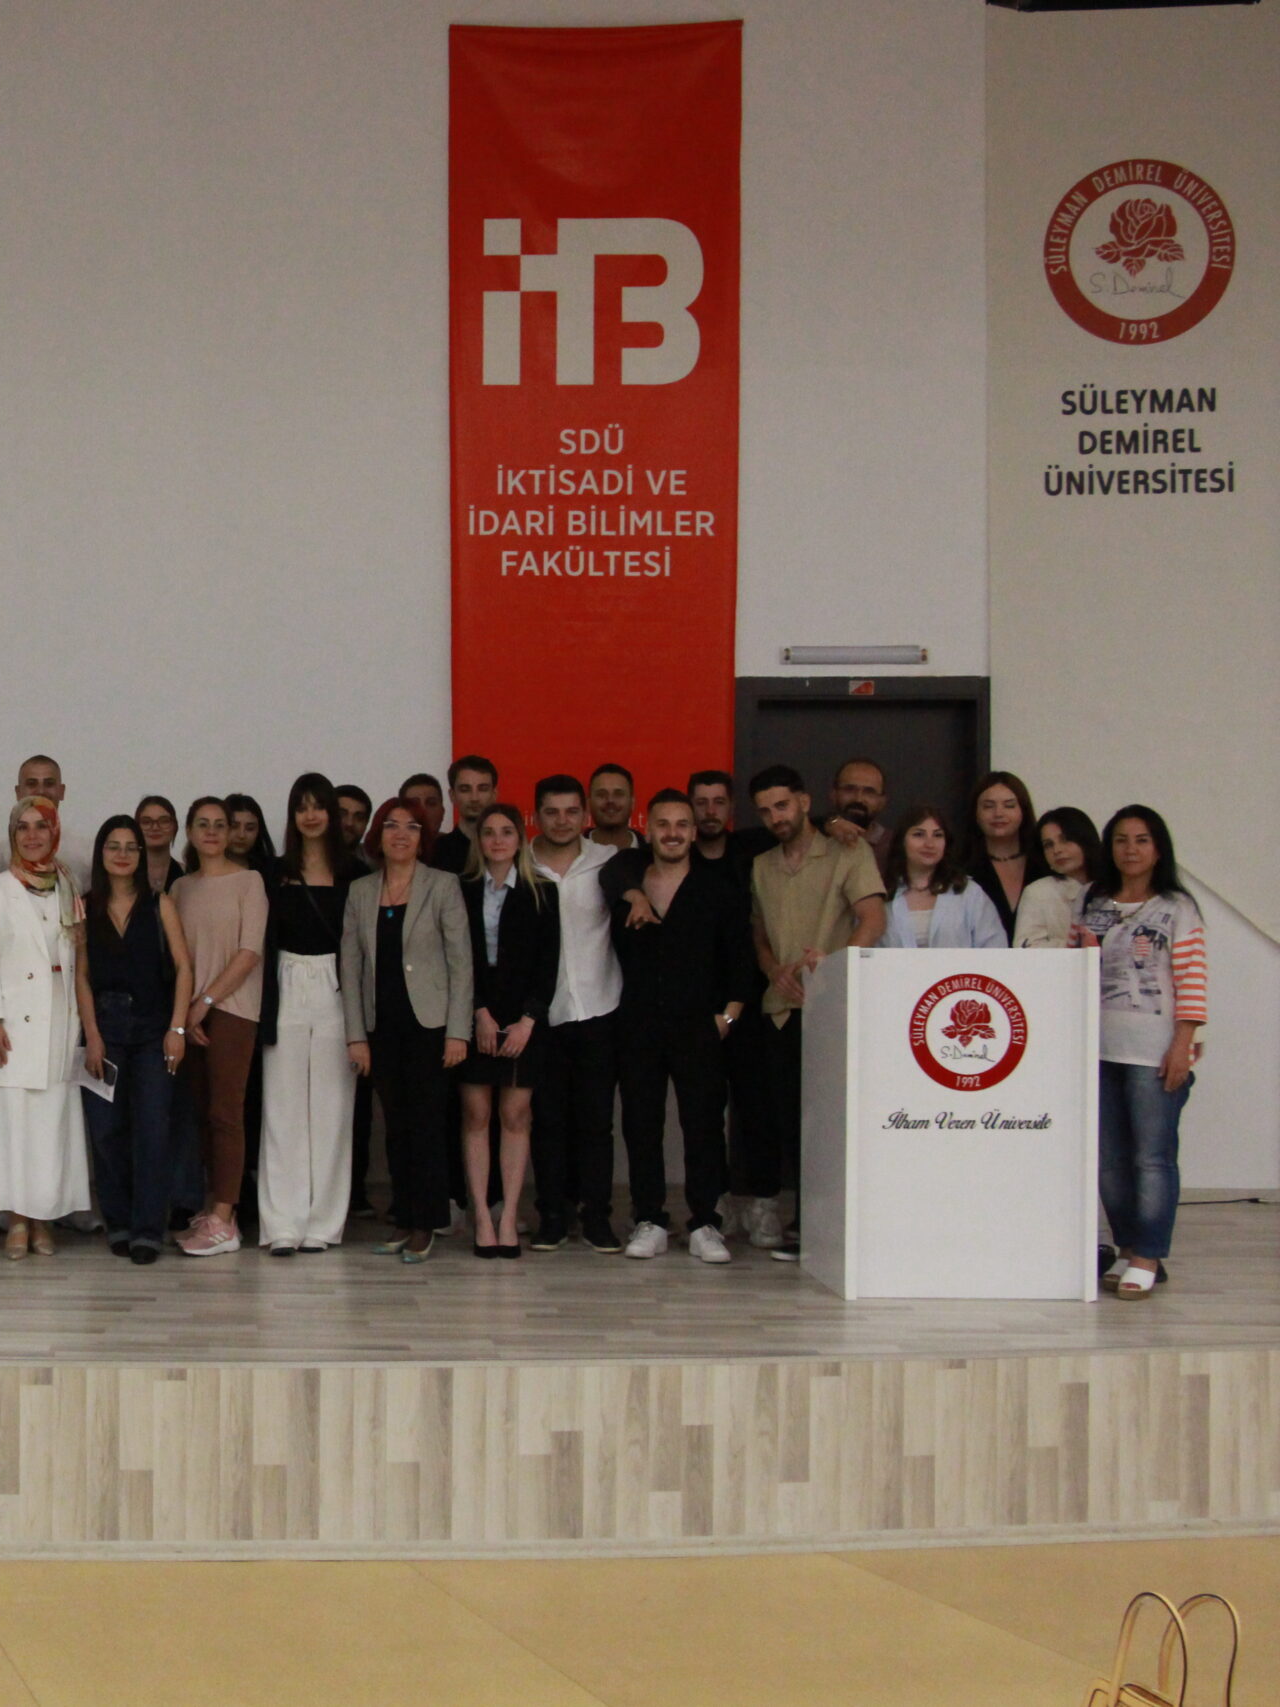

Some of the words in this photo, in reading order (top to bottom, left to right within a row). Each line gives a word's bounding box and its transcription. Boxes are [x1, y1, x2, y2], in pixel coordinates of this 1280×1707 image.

[1092, 162, 1162, 193] DEMİREL
[1119, 321, 1159, 340] 1992
[1061, 384, 1216, 415] SÜLEYMAN
[559, 423, 624, 454] SDÜ
[1078, 423, 1201, 455] DEMİREL
[497, 465, 633, 495] İKTİSADİ
[646, 470, 687, 495] VE
[1045, 461, 1234, 495] ÜNİVERSİTESİ
[468, 505, 554, 536] İDARİ
[568, 505, 715, 536] BİLİMLER
[501, 546, 671, 577] FAKÜLTESİ
[937, 976, 983, 996] DEMİREL
[955, 1076, 982, 1087] 1992
[882, 1108, 930, 1130] İlham
[935, 1111, 976, 1130] Veren
[980, 1109, 1053, 1130] Üniversite
